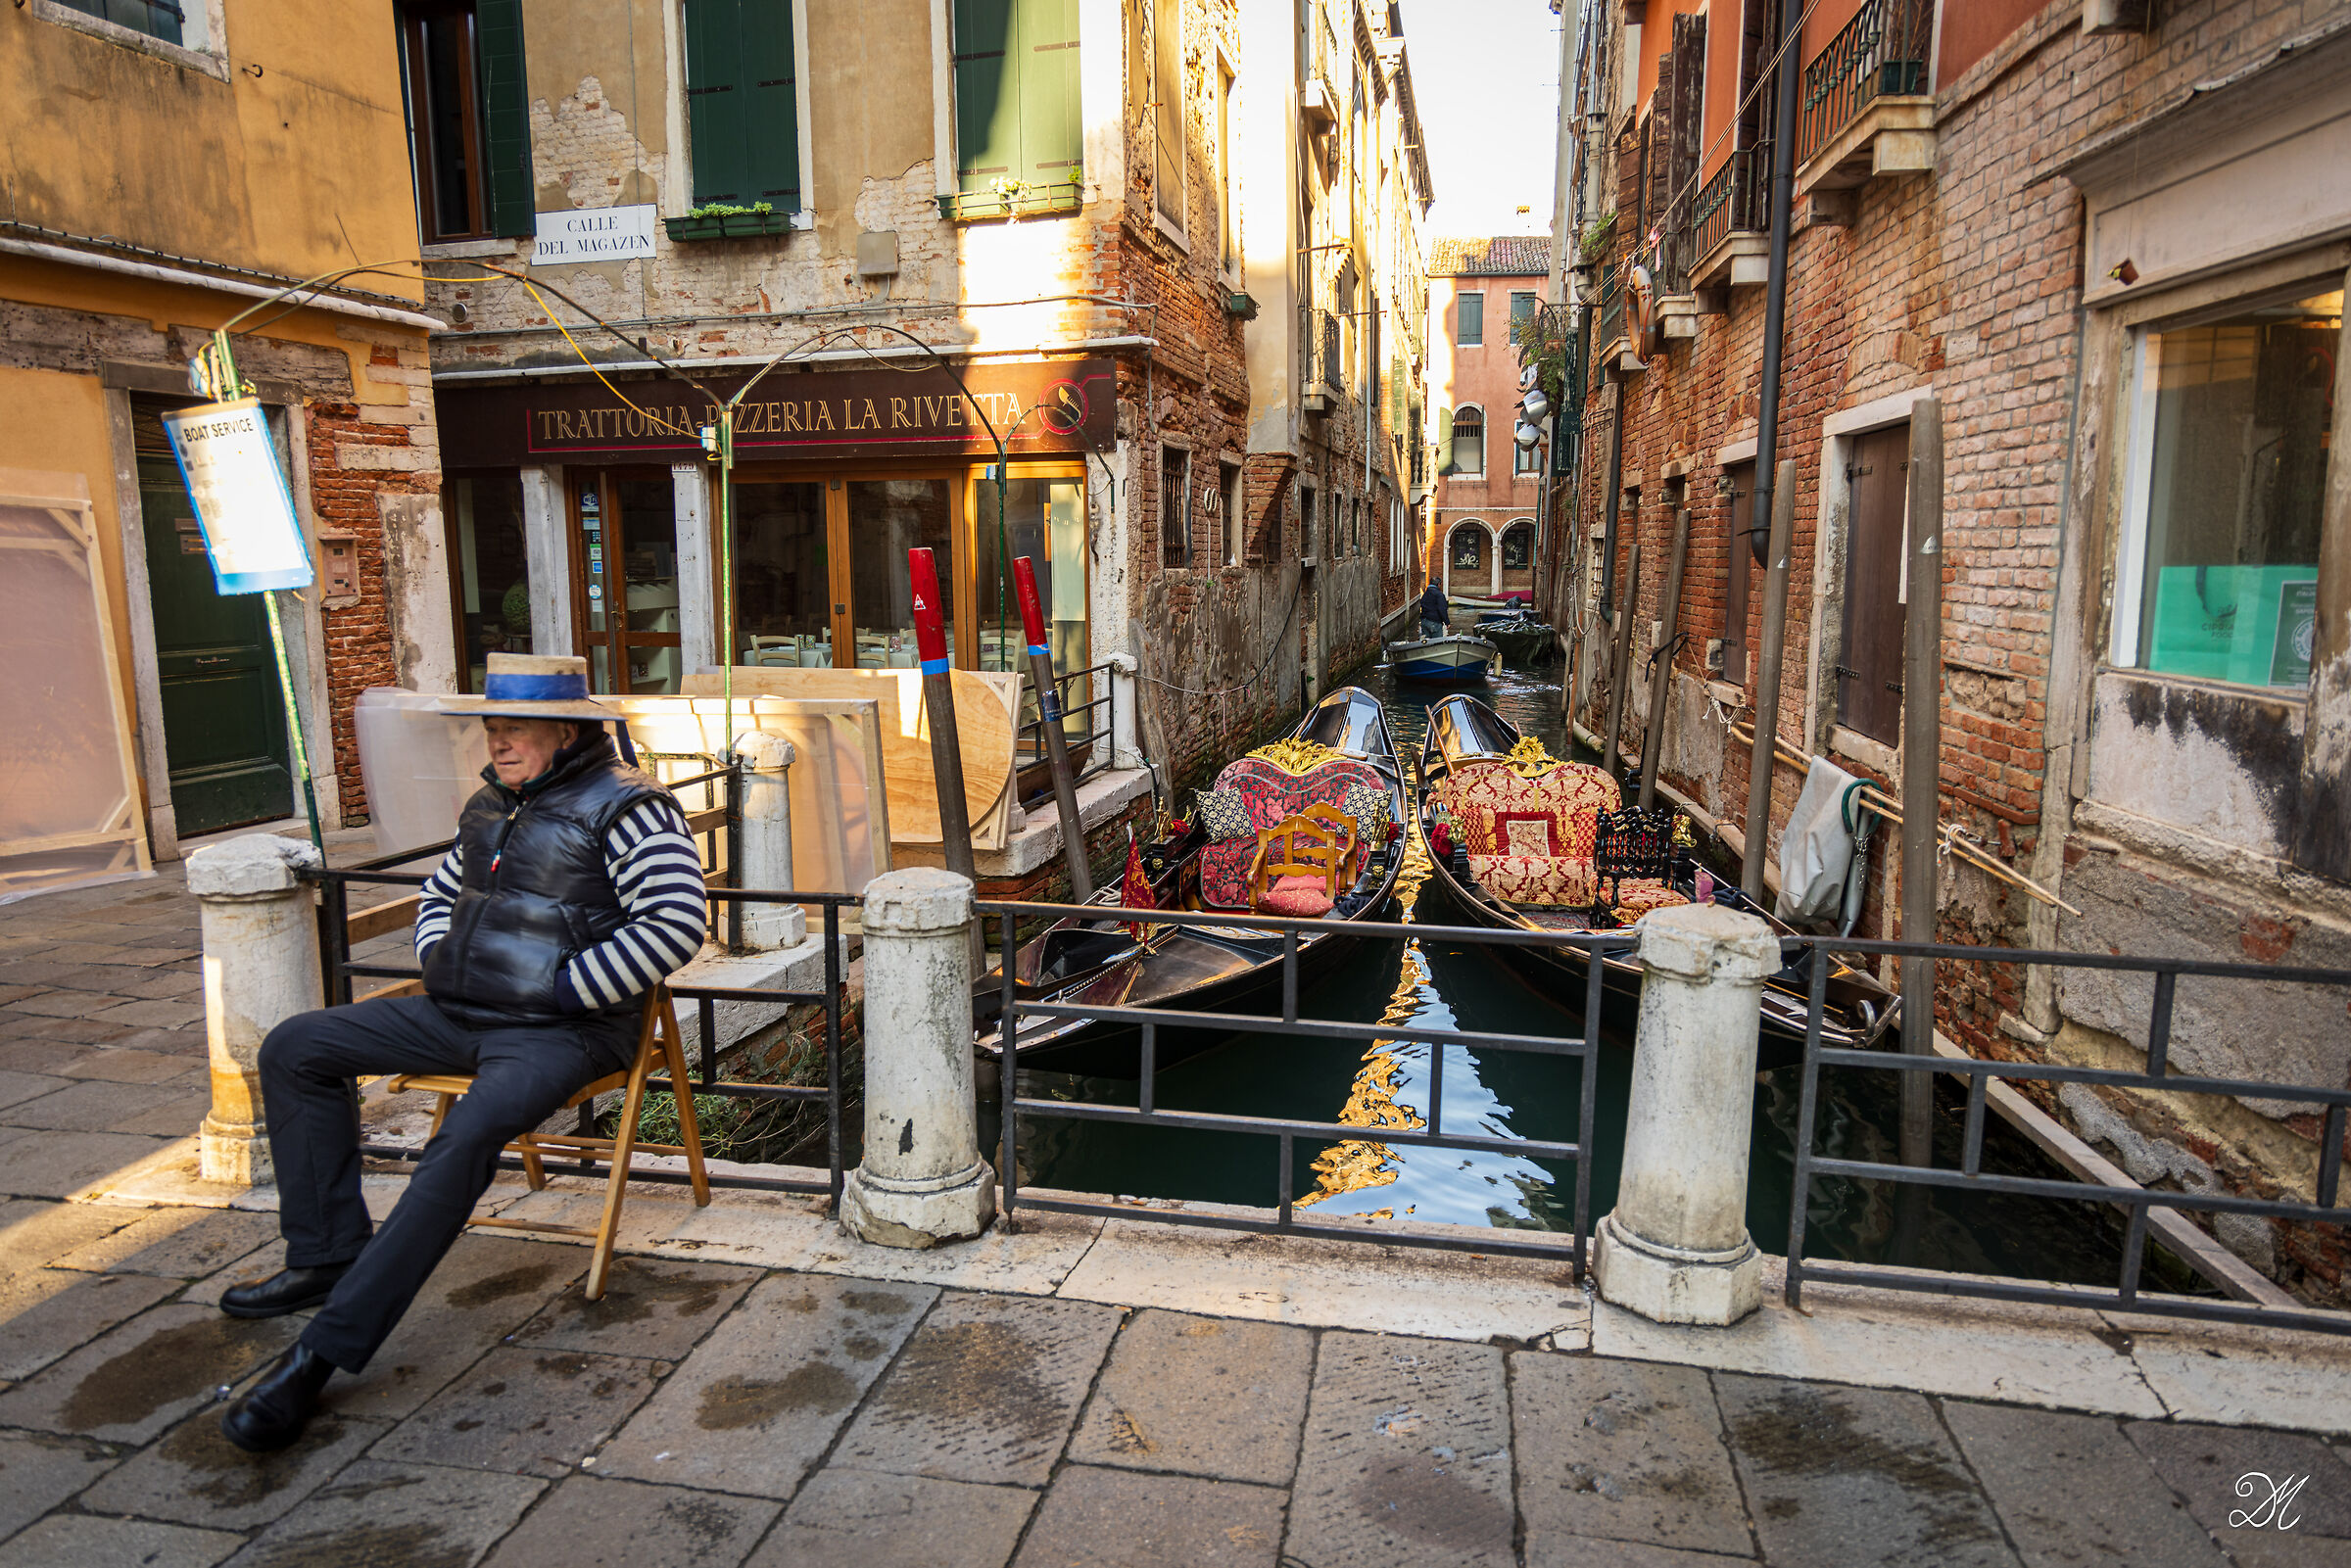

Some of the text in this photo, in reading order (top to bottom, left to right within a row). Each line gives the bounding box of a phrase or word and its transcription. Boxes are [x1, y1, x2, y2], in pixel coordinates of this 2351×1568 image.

[567, 215, 619, 233] CALLE
[539, 234, 650, 256] DEL MAGAZEN
[538, 392, 1027, 440] TRATTORIA-PZZERIA LA RIVETTA
[183, 417, 254, 442] BOAT SERVICE
